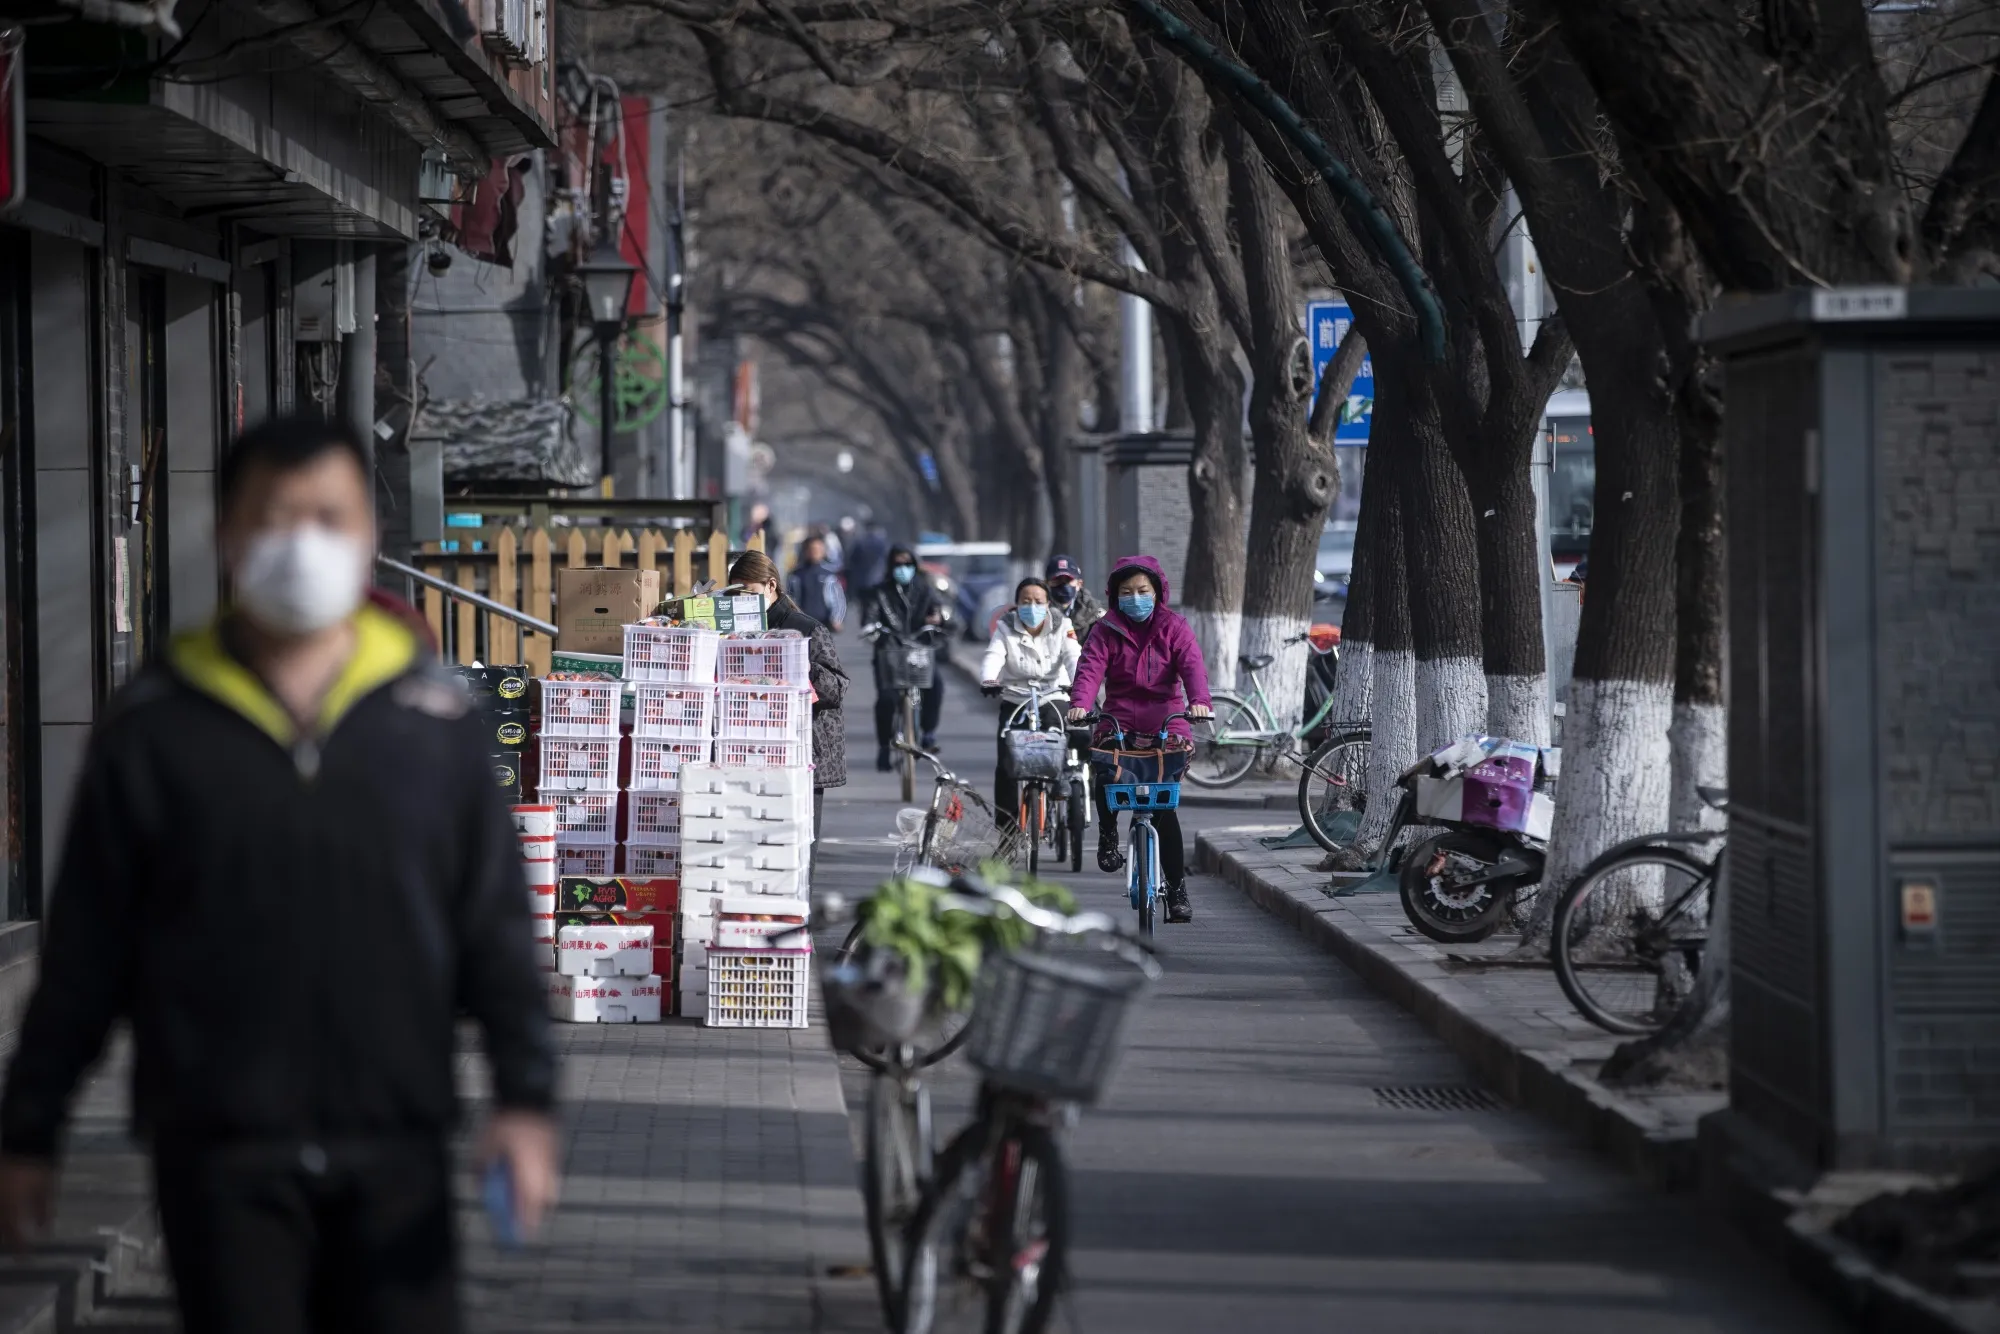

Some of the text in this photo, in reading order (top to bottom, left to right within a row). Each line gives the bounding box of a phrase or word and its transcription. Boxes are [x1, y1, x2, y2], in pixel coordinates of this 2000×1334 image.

[597, 887, 617, 895] RVR
[592, 894, 617, 903] AGRO
[561, 940, 593, 950] 山河果业
[575, 988, 607, 999] 山河果业
